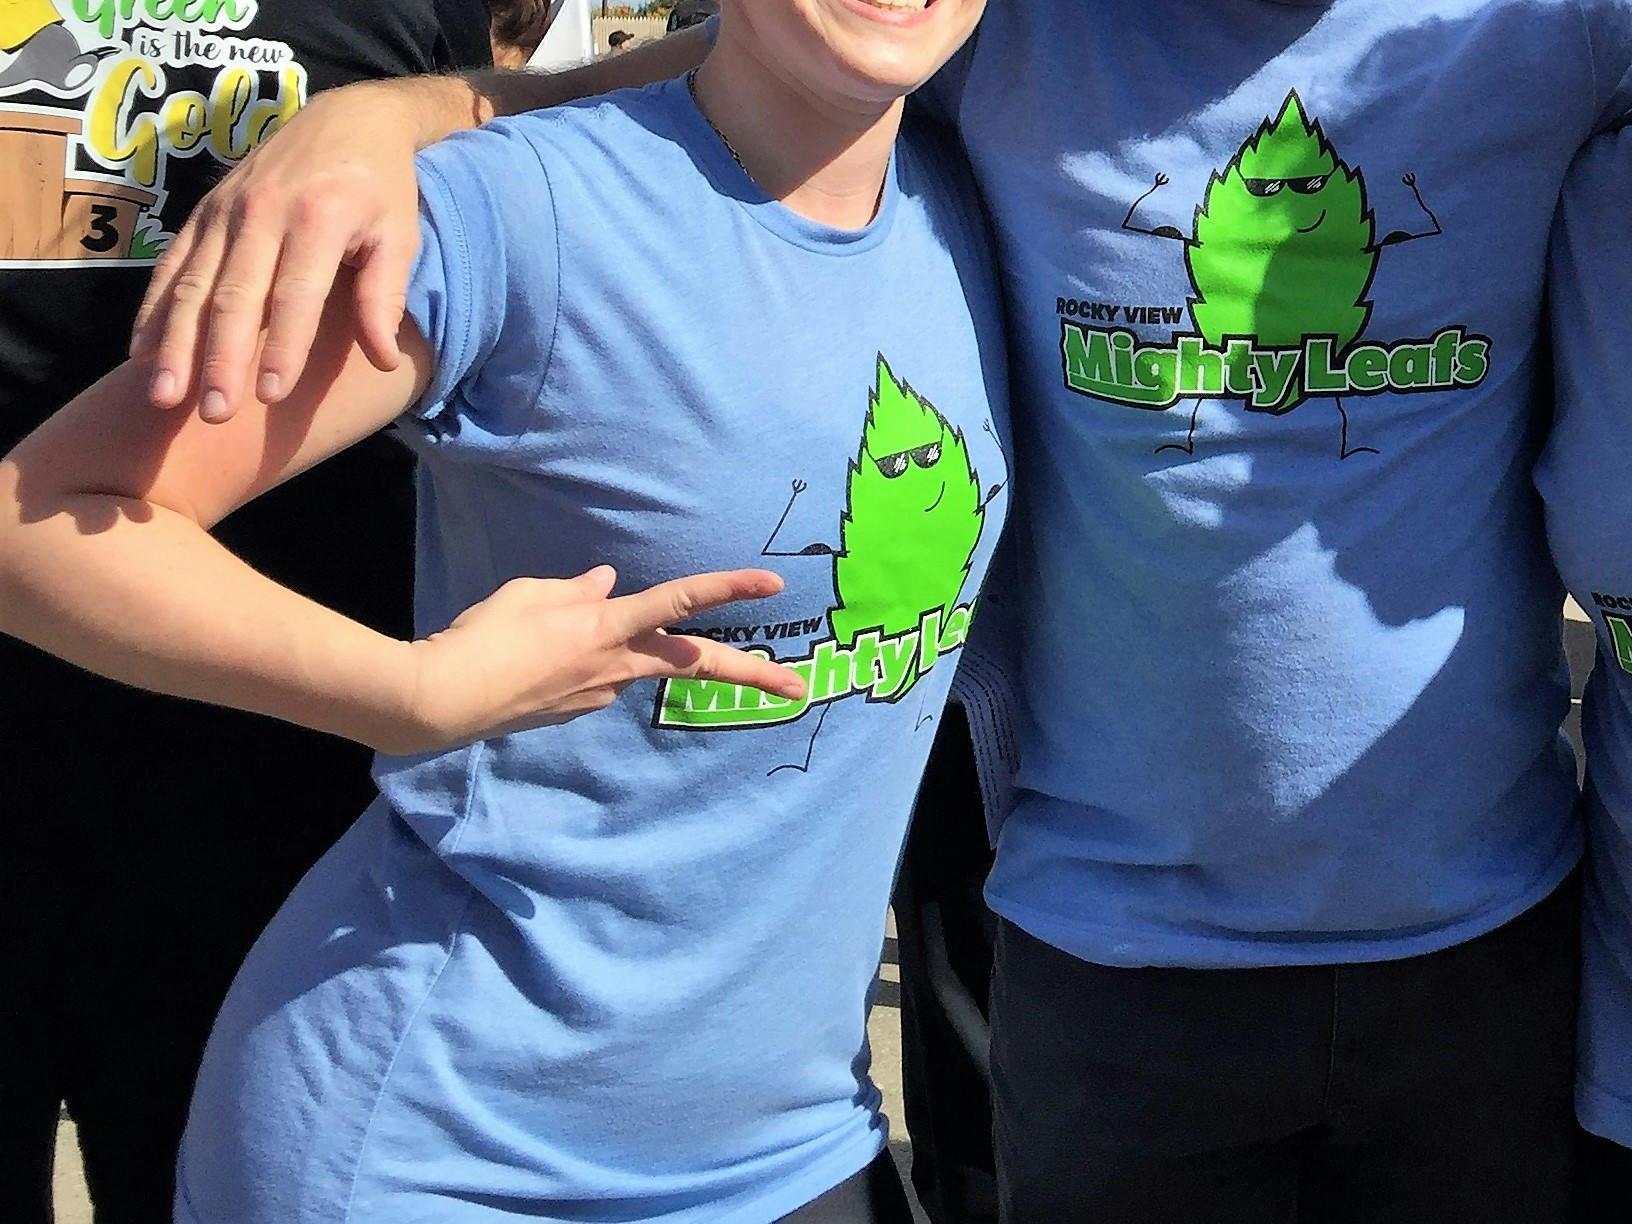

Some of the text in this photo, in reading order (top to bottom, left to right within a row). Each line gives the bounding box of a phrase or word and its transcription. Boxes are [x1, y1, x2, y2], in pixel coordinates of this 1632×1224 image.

[139, 30, 287, 64] is the new
[90, 59, 302, 186] Gold
[80, 204, 119, 252] 3
[1056, 297, 1183, 325] ROCKY VIEW
[1063, 323, 1489, 408] Mighty Leafs
[764, 615, 823, 641] VIEW
